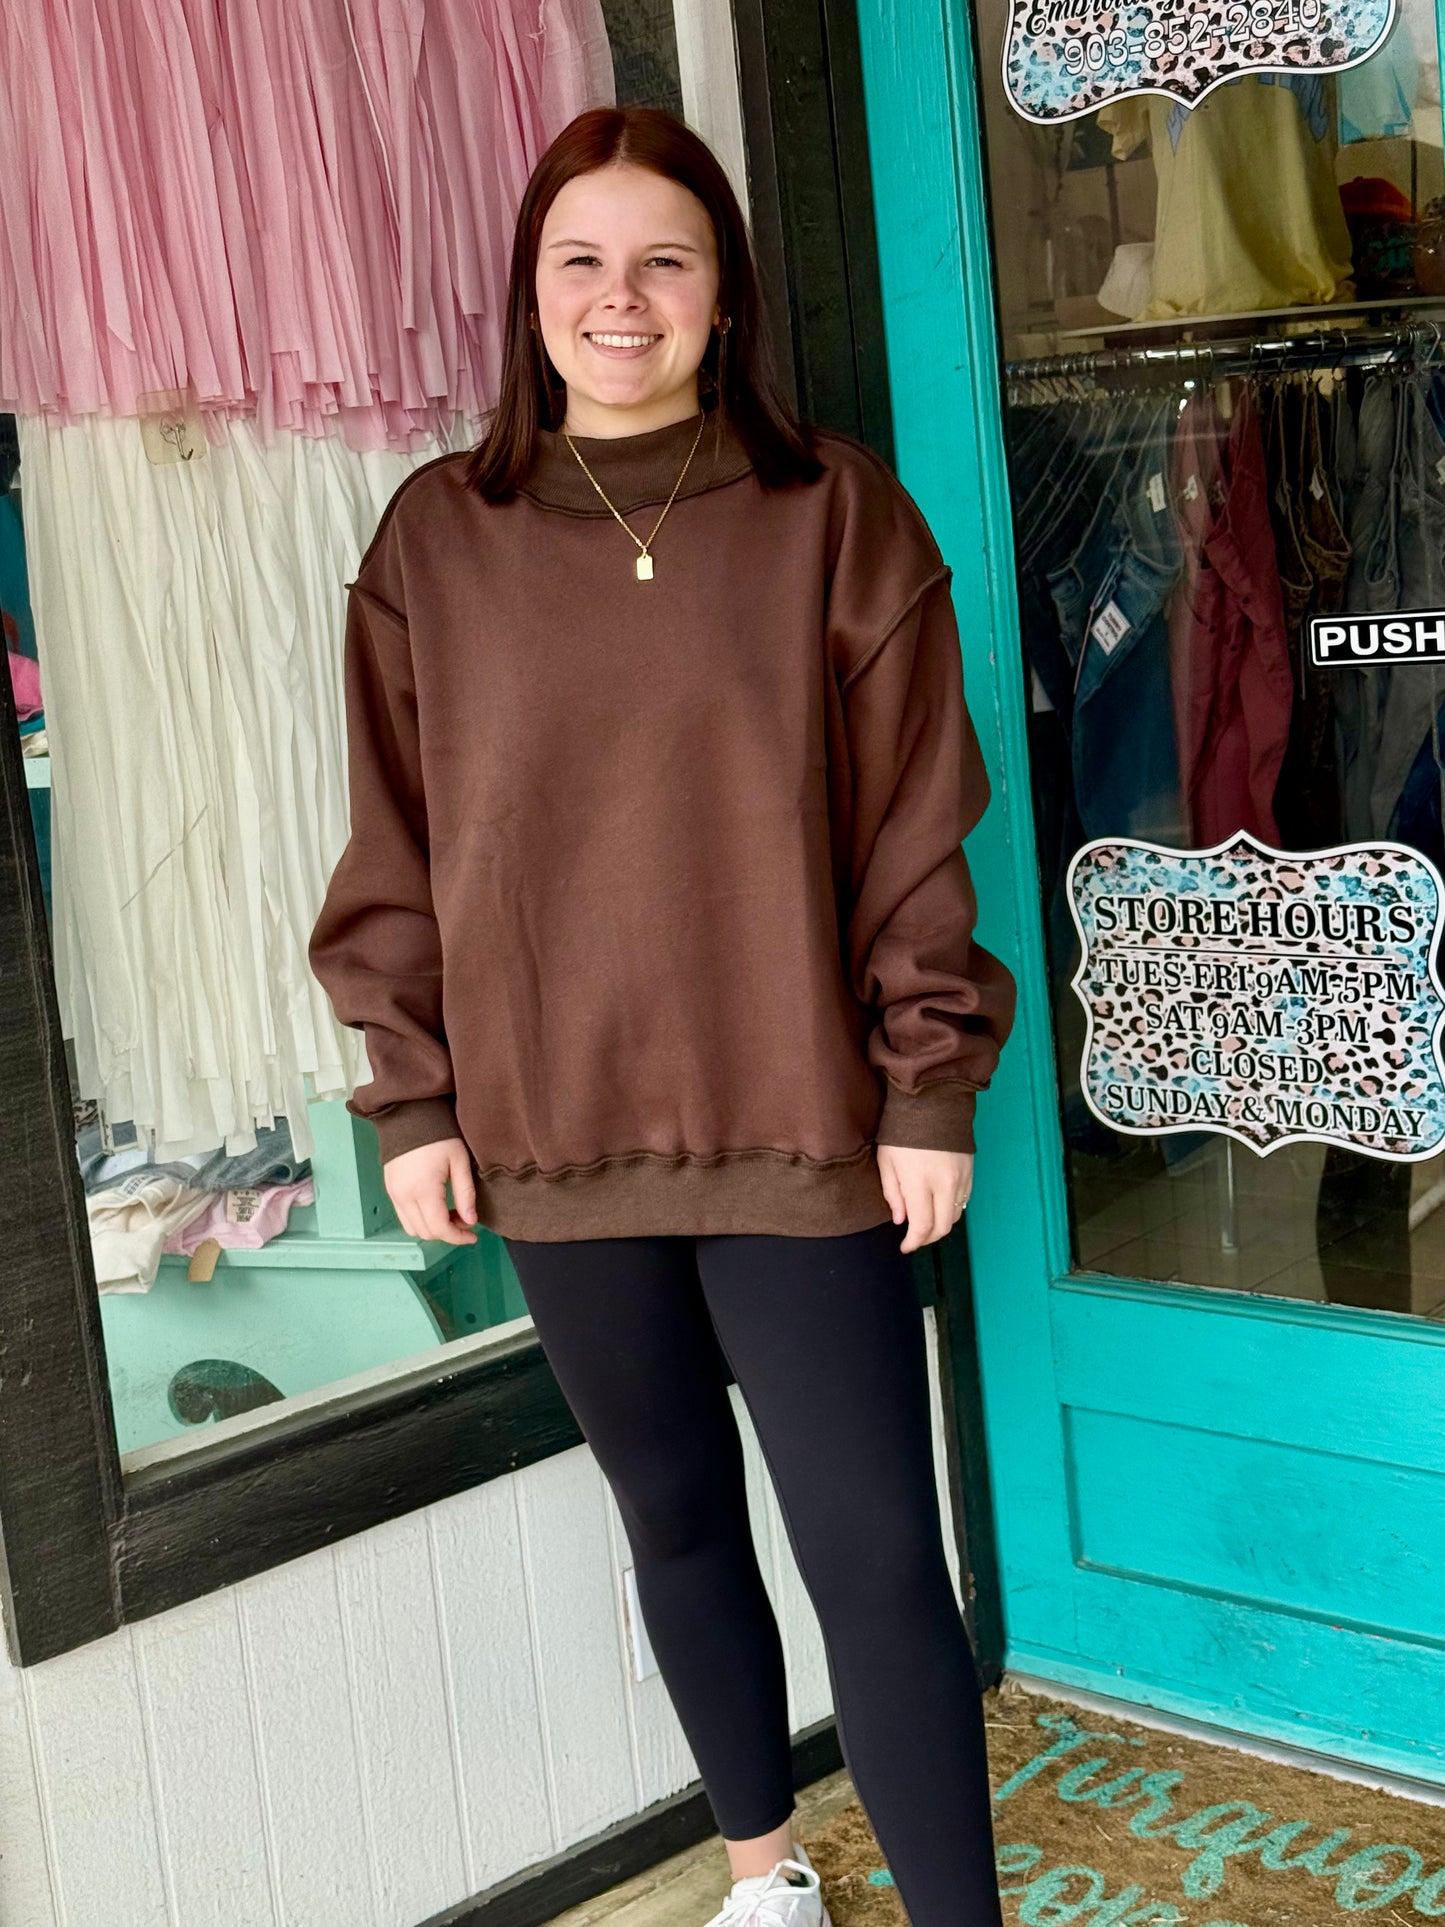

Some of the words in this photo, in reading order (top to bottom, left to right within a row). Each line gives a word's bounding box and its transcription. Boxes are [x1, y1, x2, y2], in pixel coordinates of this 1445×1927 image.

[1064, 0, 1322, 75] 903-852-2840
[1319, 620, 1445, 657] PUSH
[1094, 897, 1238, 937] STORE
[1249, 902, 1416, 943] HOURS
[1100, 959, 1250, 992] TUES-FRI
[1255, 968, 1417, 1003] 9AM-5PM
[1146, 1004, 1204, 1033] SAT
[1212, 1010, 1369, 1045] 9AM-3PM
[1191, 1050, 1323, 1084] CLOSED
[1107, 1085, 1231, 1120] SUNDAY
[1241, 1102, 1266, 1124] &
[1276, 1100, 1426, 1137] MONDAY
